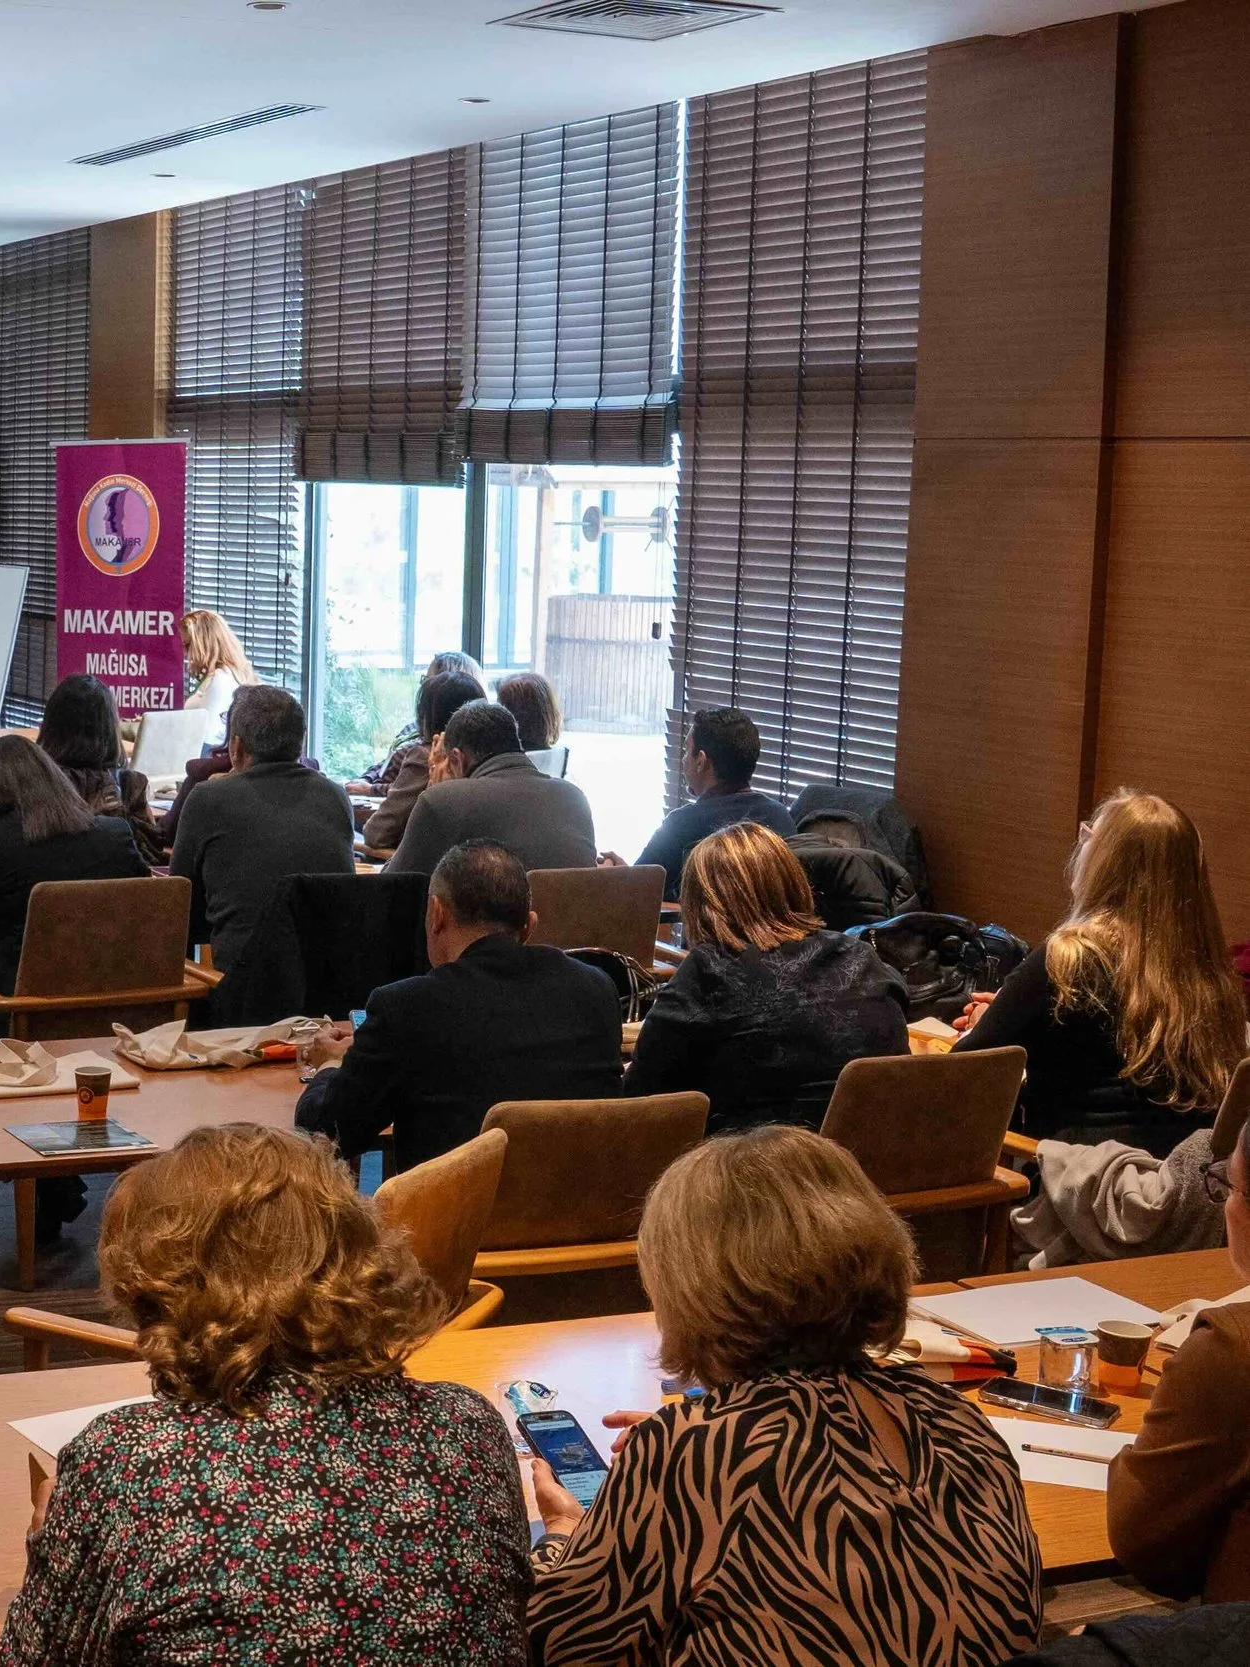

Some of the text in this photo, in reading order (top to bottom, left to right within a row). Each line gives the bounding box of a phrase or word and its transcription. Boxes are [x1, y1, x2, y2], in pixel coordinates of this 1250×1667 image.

[95, 537, 141, 546] MAKAMER
[63, 609, 174, 636] MAKAMER
[86, 648, 148, 676] MAĞUSA
